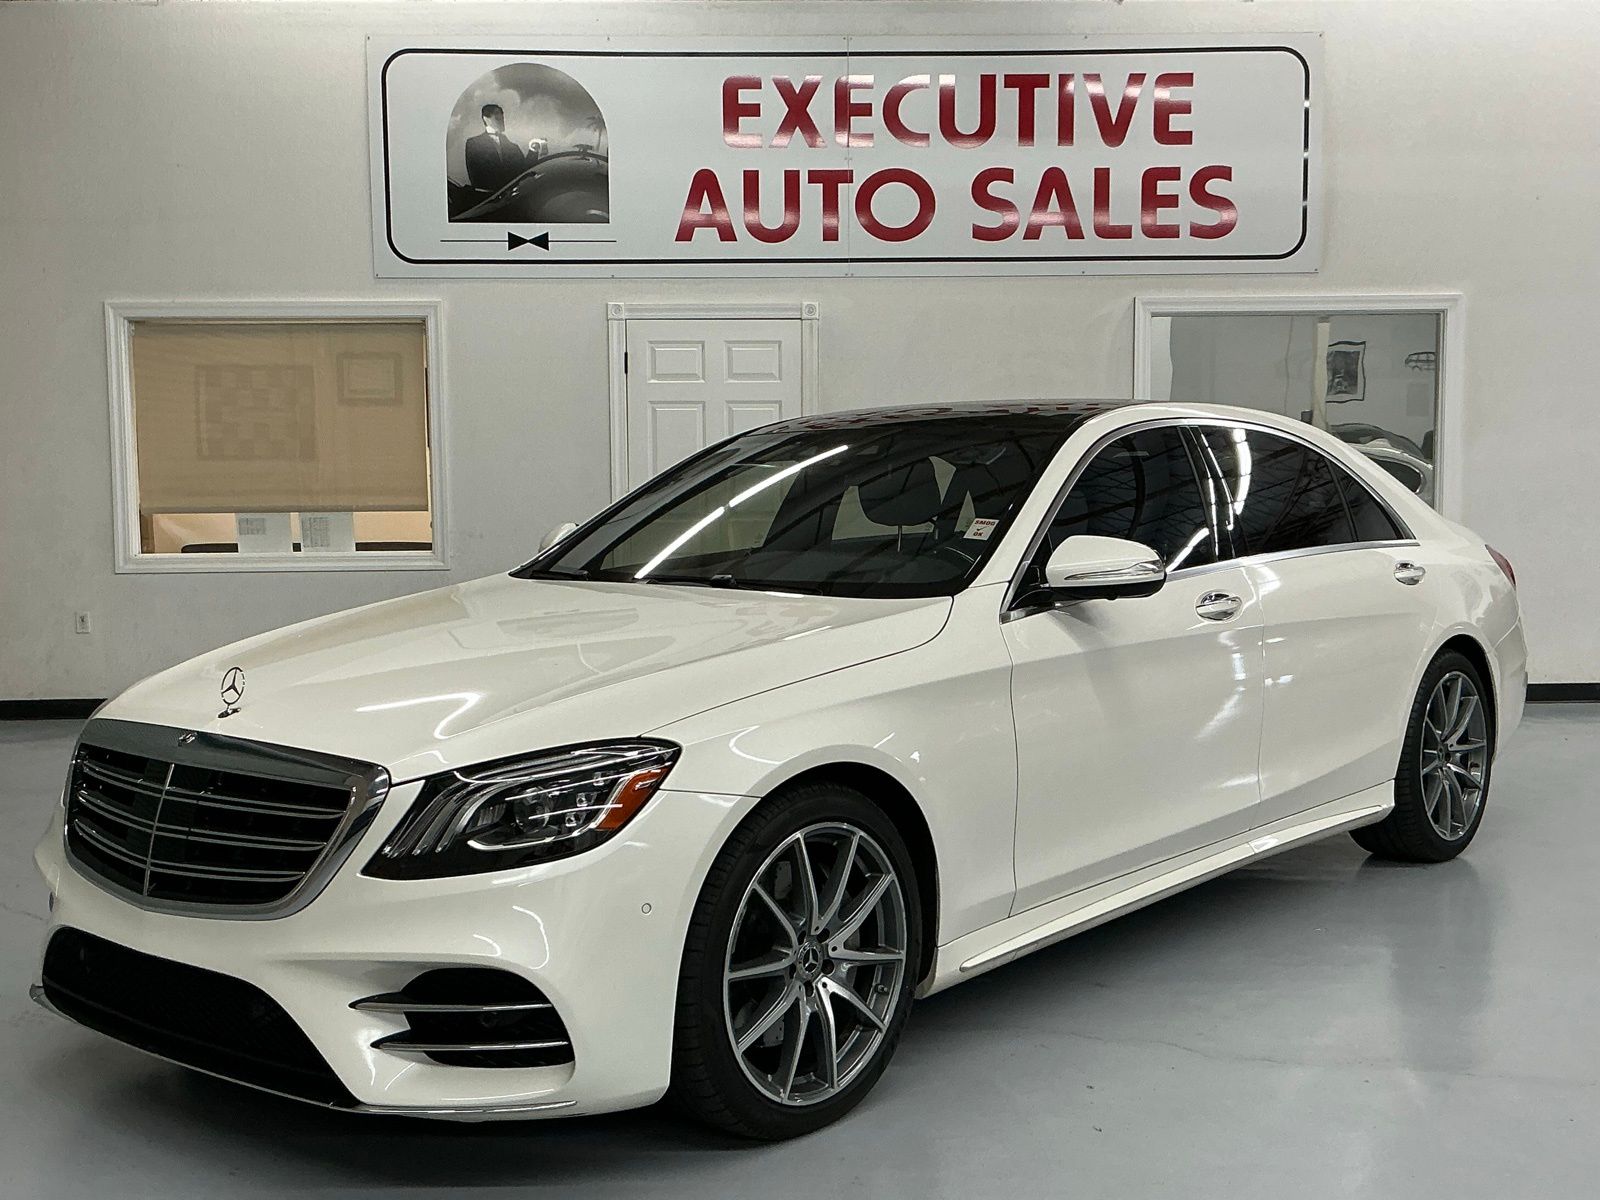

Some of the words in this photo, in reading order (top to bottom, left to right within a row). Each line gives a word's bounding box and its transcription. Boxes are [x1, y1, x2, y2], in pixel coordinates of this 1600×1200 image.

[722, 72, 1194, 148] EXECUTIVE
[675, 168, 936, 243] AUTO
[971, 165, 1237, 241] SALES
